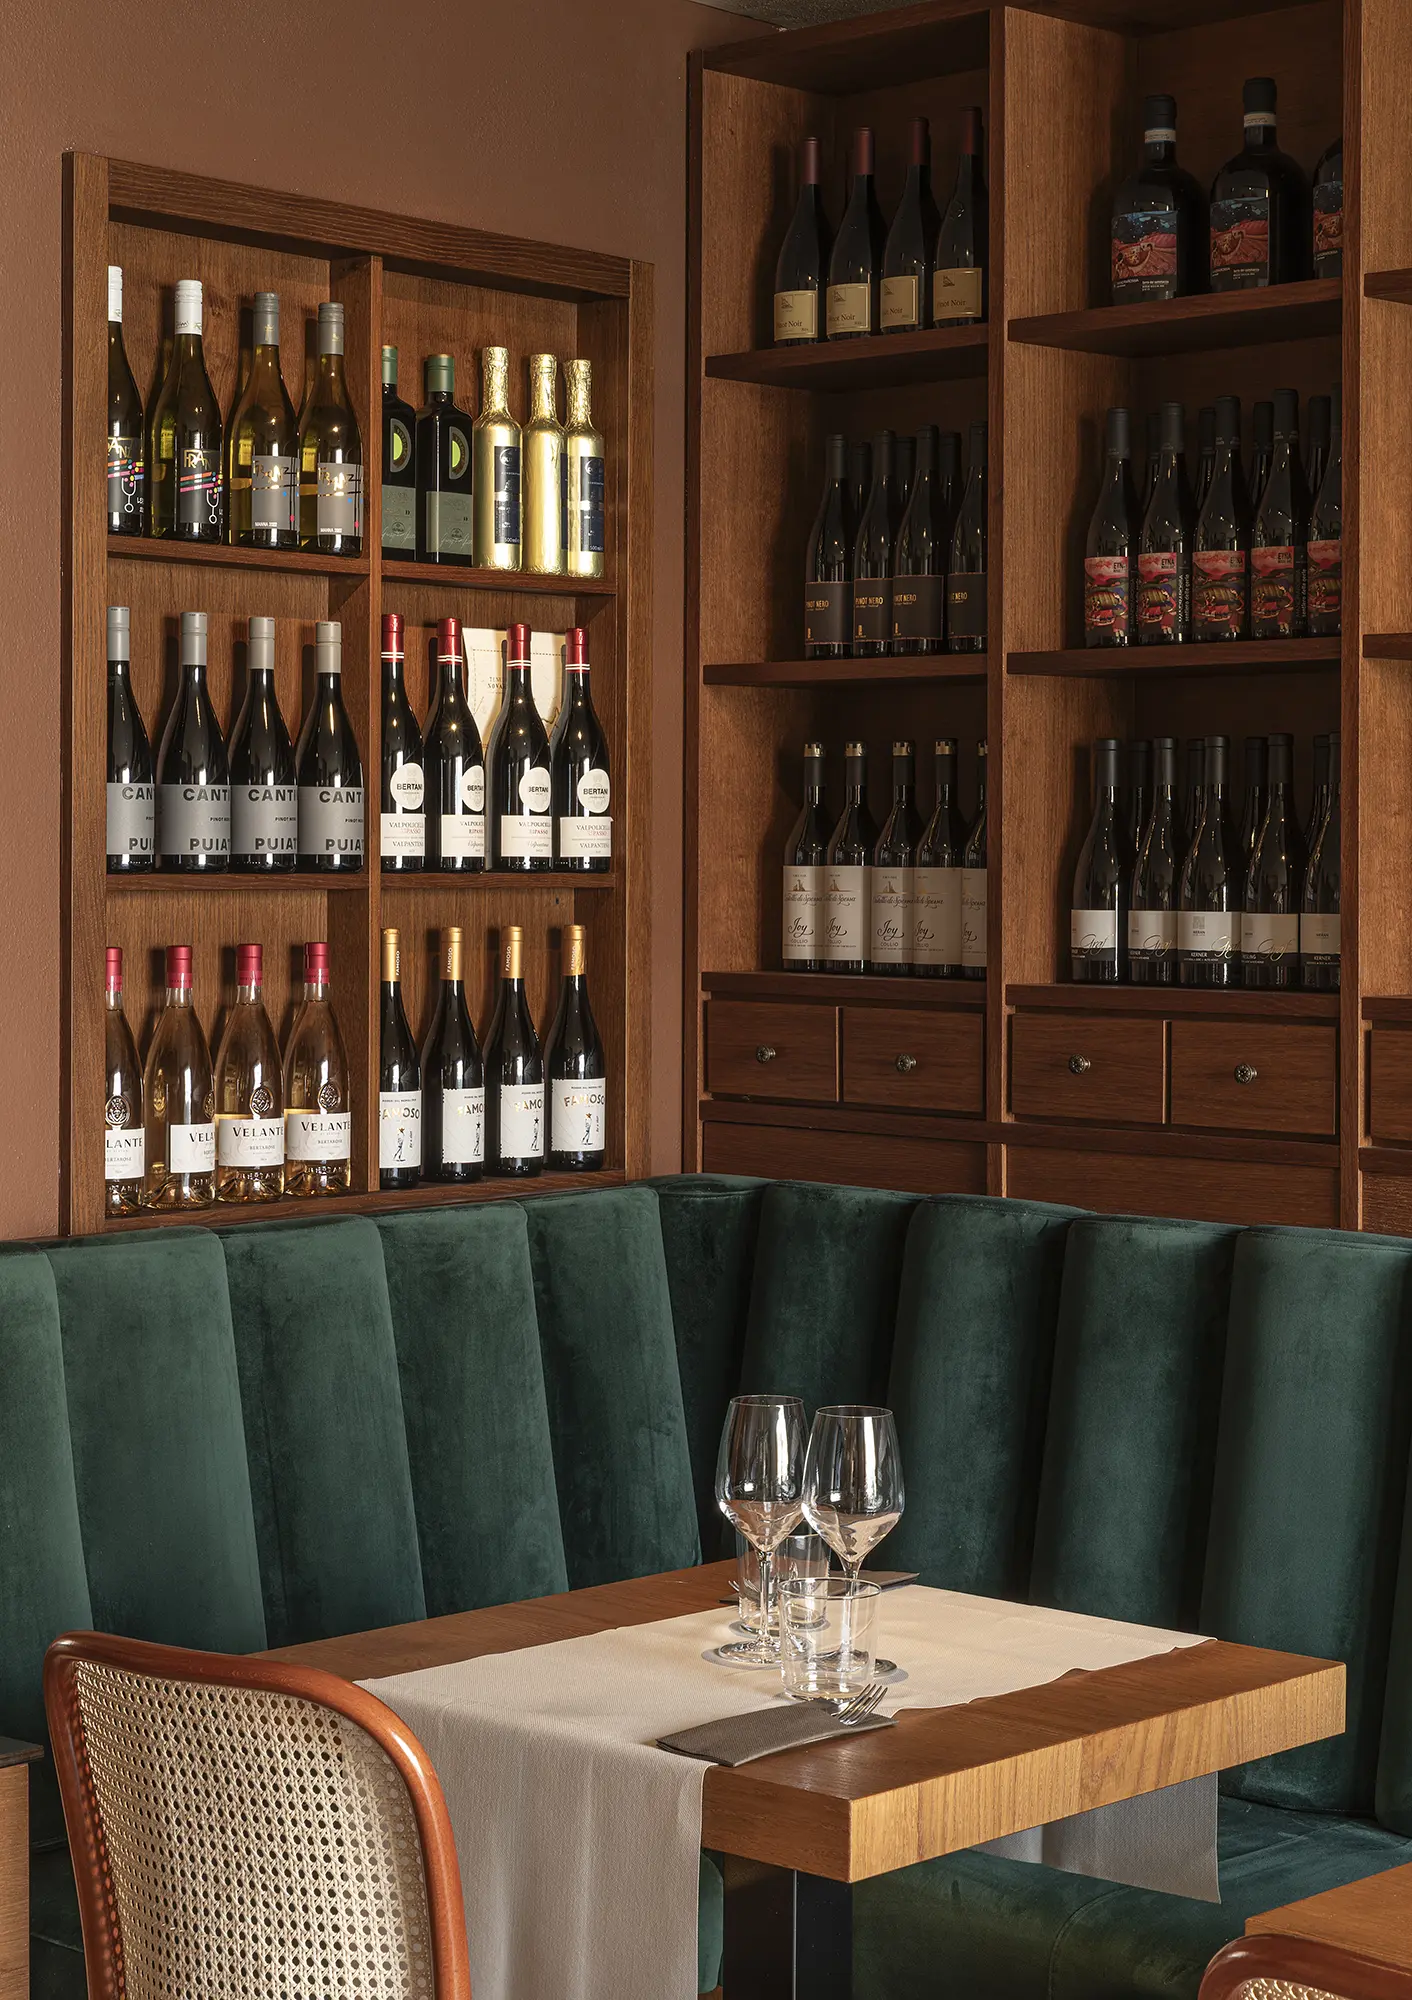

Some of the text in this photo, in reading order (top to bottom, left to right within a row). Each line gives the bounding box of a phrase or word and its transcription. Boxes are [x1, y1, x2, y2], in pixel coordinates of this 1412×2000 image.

[816, 600, 830, 608] NERO
[868, 596, 884, 605] NERO
[788, 917, 814, 939] Joy
[826, 917, 847, 939] Joy
[877, 919, 904, 941] Joy
[915, 920, 934, 942] Joy
[1080, 934, 1109, 955] Graf
[1143, 934, 1174, 957] Graf
[1257, 938, 1293, 961] Graf
[233, 1126, 284, 1137] VELANTE
[302, 1121, 350, 1132] VELANTE
